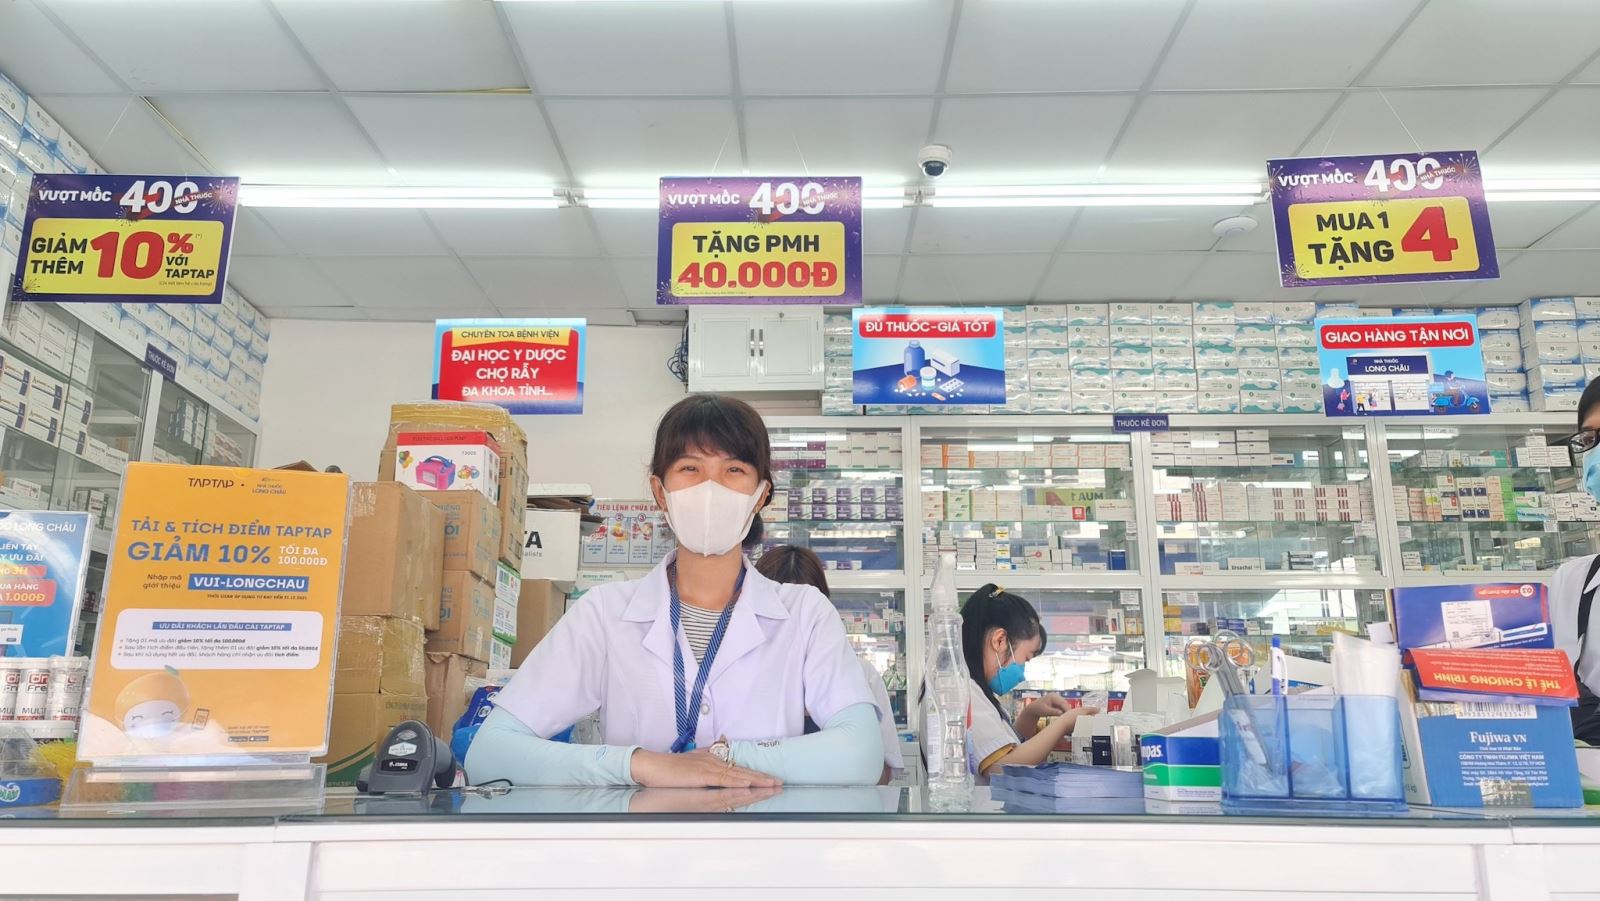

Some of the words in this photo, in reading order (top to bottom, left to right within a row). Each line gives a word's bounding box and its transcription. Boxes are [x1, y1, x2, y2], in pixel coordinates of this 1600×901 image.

[1278, 175, 1319, 188] VƯỢT
[1321, 168, 1354, 183] MỐC
[38, 189, 79, 204] VƯỢT
[80, 186, 112, 202] MỐC
[668, 194, 709, 207] VƯỢT
[709, 189, 740, 205] MỐC
[1316, 211, 1375, 232] MUA
[1377, 211, 1389, 229] 1
[1401, 206, 1459, 262] 4
[31, 232, 88, 254] GIẢM
[693, 230, 760, 258] TẶNG
[766, 235, 819, 253] PMH
[166, 253, 188, 266] VỚI
[1308, 236, 1394, 271] TẶNG
[30, 257, 84, 275] THÊM
[165, 268, 215, 279] TAPTAP
[678, 261, 837, 288] 40.000Đ
[865, 319, 882, 332] ĐỦ
[963, 318, 989, 332] TỐT
[461, 329, 495, 338] CHUYÊN
[517, 329, 539, 339] BỆNH
[540, 329, 559, 340] VIỆN
[1325, 331, 1361, 344] GIAO
[1364, 327, 1406, 343] HÀNG
[1409, 327, 1439, 345] TẬN
[1442, 327, 1469, 340] NƠI
[451, 349, 475, 364] ĐẠI
[478, 349, 510, 364] HỌC
[513, 349, 522, 360] Y
[525, 348, 567, 364] DƯỢC
[476, 367, 509, 382] CHỢ
[511, 362, 540, 379] RẪY
[1388, 364, 1410, 372] CHÂU
[462, 386, 478, 396] ĐA
[482, 386, 515, 396] KHOA
[1116, 418, 1140, 427] THUỐC
[188, 477, 234, 489] TAPTAP
[47, 521, 77, 533] CHÂU
[131, 516, 160, 532] TẢI
[165, 521, 176, 532] &
[182, 519, 224, 534] TÍCH
[228, 519, 271, 536] ĐIỂM
[276, 525, 332, 538] TAPTAP
[20, 543, 39, 551] TAY
[524, 531, 543, 549] A
[128, 536, 209, 562] GIẢM
[218, 545, 271, 564] 10%
[279, 545, 300, 555] TỐI
[303, 547, 318, 555] ĐA
[278, 556, 327, 566] 100.000Đ
[143, 581, 159, 590] giới
[161, 581, 181, 590] thiệu
[147, 574, 170, 583] Nhập
[193, 576, 305, 589] VUI-LONGCHAU
[14, 582, 39, 590] HÀNG
[1434, 672, 1468, 686] TRÌNH
[1470, 673, 1523, 688] CHƯƠNG
[1525, 675, 1538, 689] LỆ
[1539, 678, 1561, 693] THỂ
[1470, 731, 1511, 745] Fujiwa
